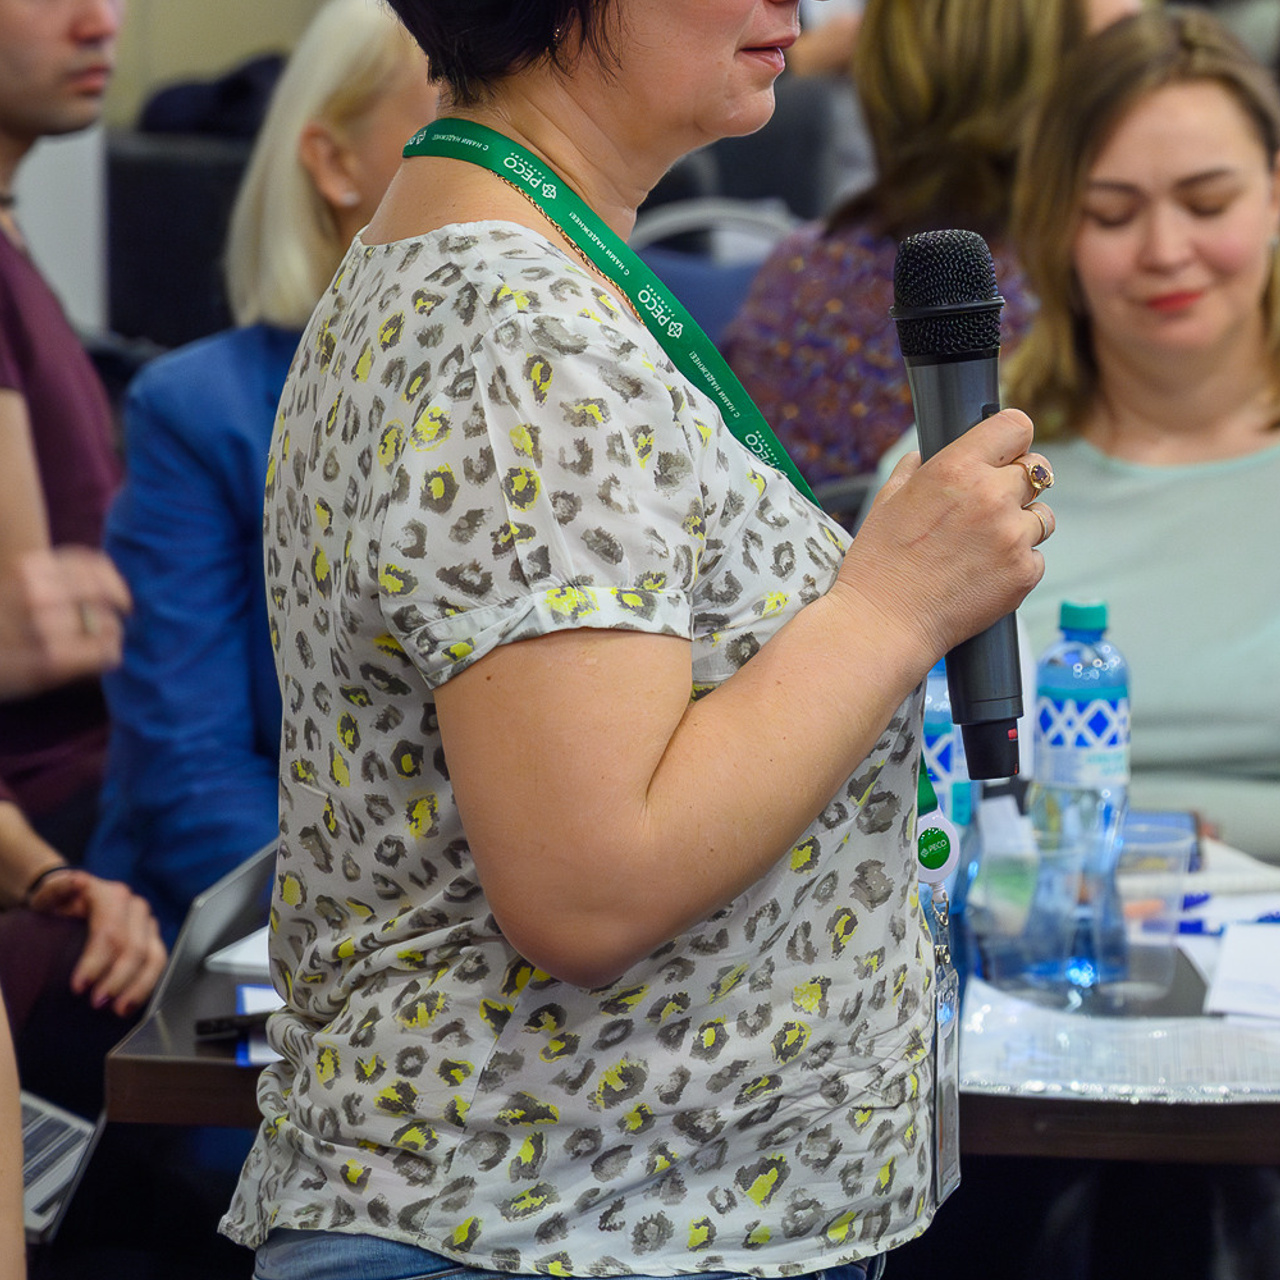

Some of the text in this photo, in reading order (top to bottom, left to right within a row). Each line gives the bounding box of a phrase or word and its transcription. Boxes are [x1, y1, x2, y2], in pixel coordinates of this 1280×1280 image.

[503, 157, 542, 188] РЕСО
[605, 249, 625, 271] НАМИ
[638, 289, 671, 326] РЕСО
[717, 390, 736, 414] НАМИ
